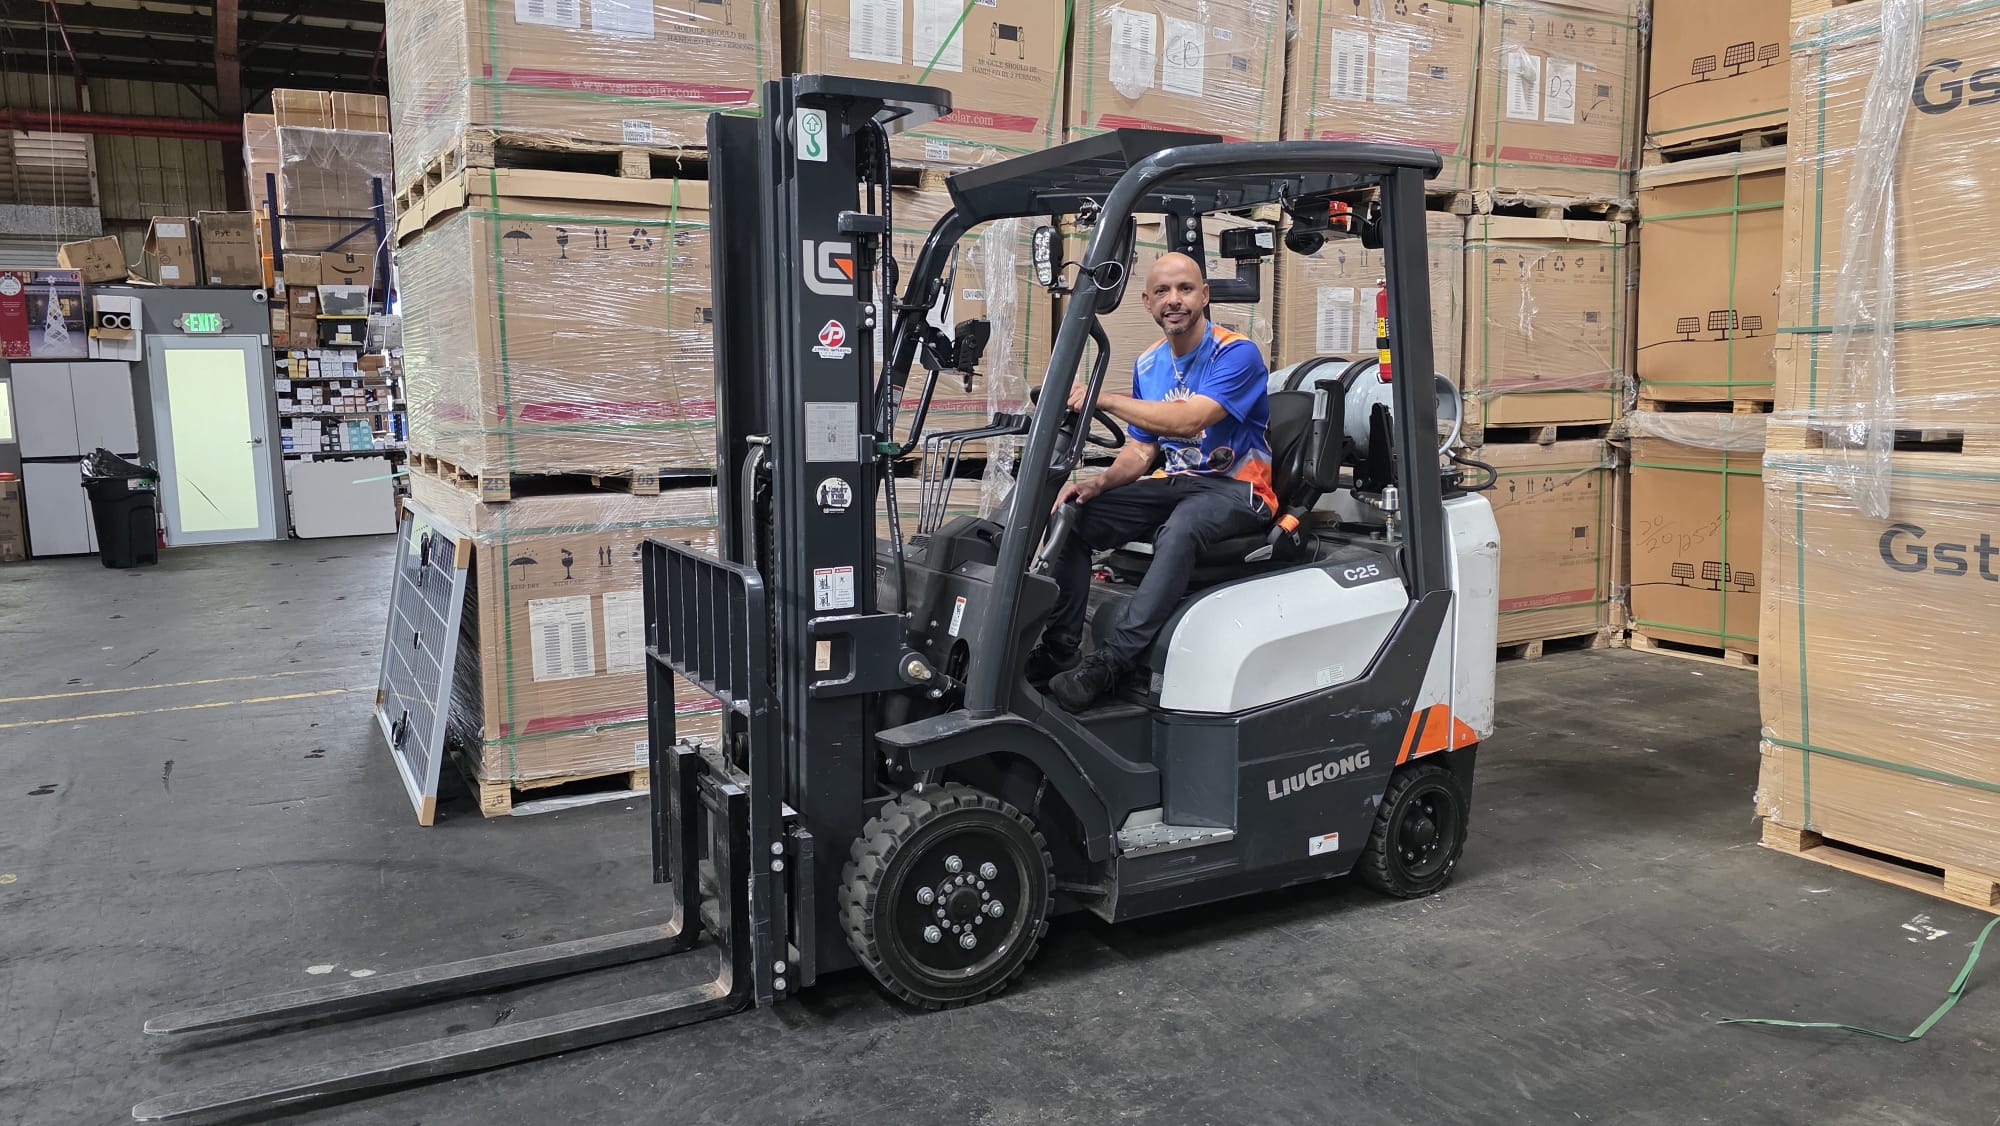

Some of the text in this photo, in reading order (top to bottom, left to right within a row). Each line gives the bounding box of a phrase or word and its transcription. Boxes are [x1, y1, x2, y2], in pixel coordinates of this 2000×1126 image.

[189, 313, 216, 332] EXIT
[1343, 564, 1380, 582] C25
[1267, 750, 1371, 801] LIUGONG
